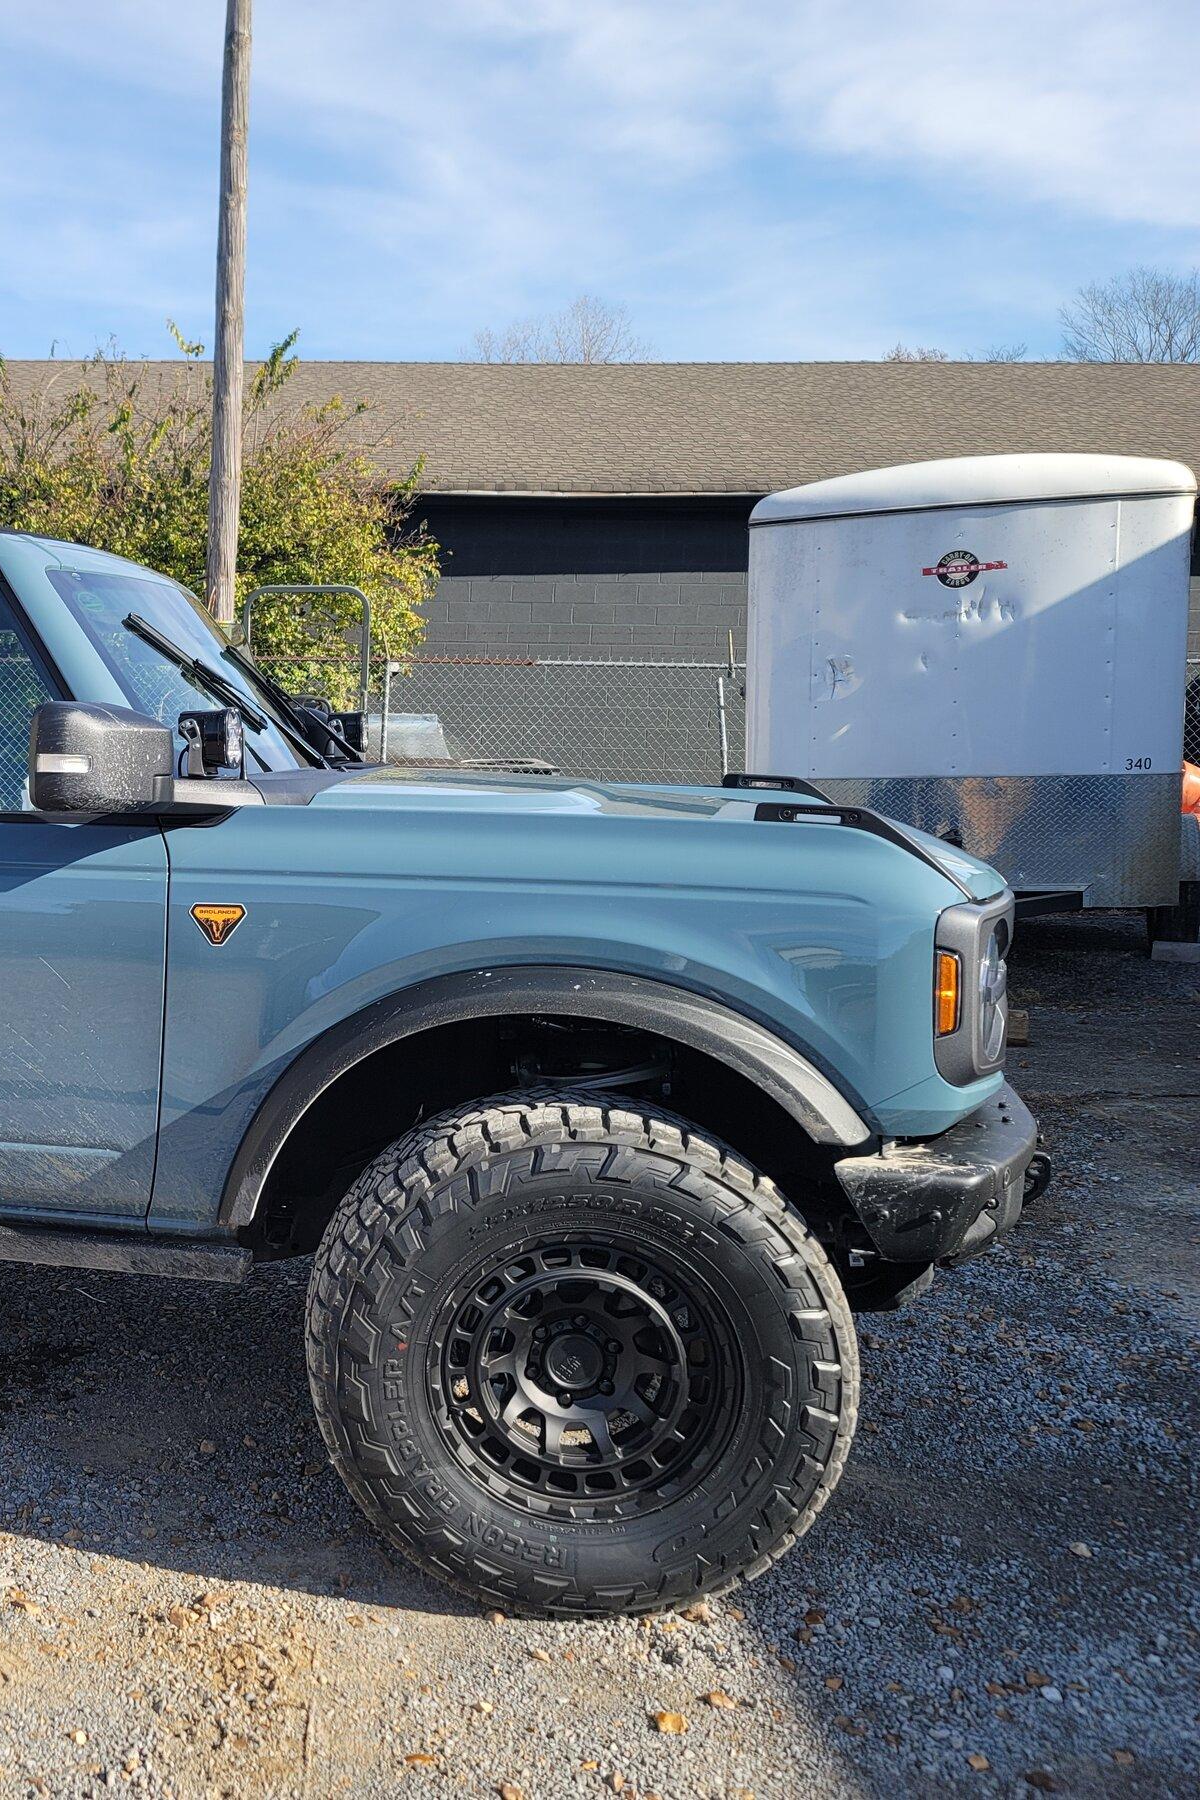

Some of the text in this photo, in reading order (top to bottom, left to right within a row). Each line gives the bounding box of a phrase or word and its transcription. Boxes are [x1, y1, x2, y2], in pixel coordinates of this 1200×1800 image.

[941, 551, 976, 565] CARRY-ON
[931, 564, 987, 573] TRAILER
[945, 576, 971, 586] CARGO
[1125, 757, 1152, 771] 340
[382, 1358, 461, 1514] GRAPPLER
[462, 1512, 568, 1570] RECON
